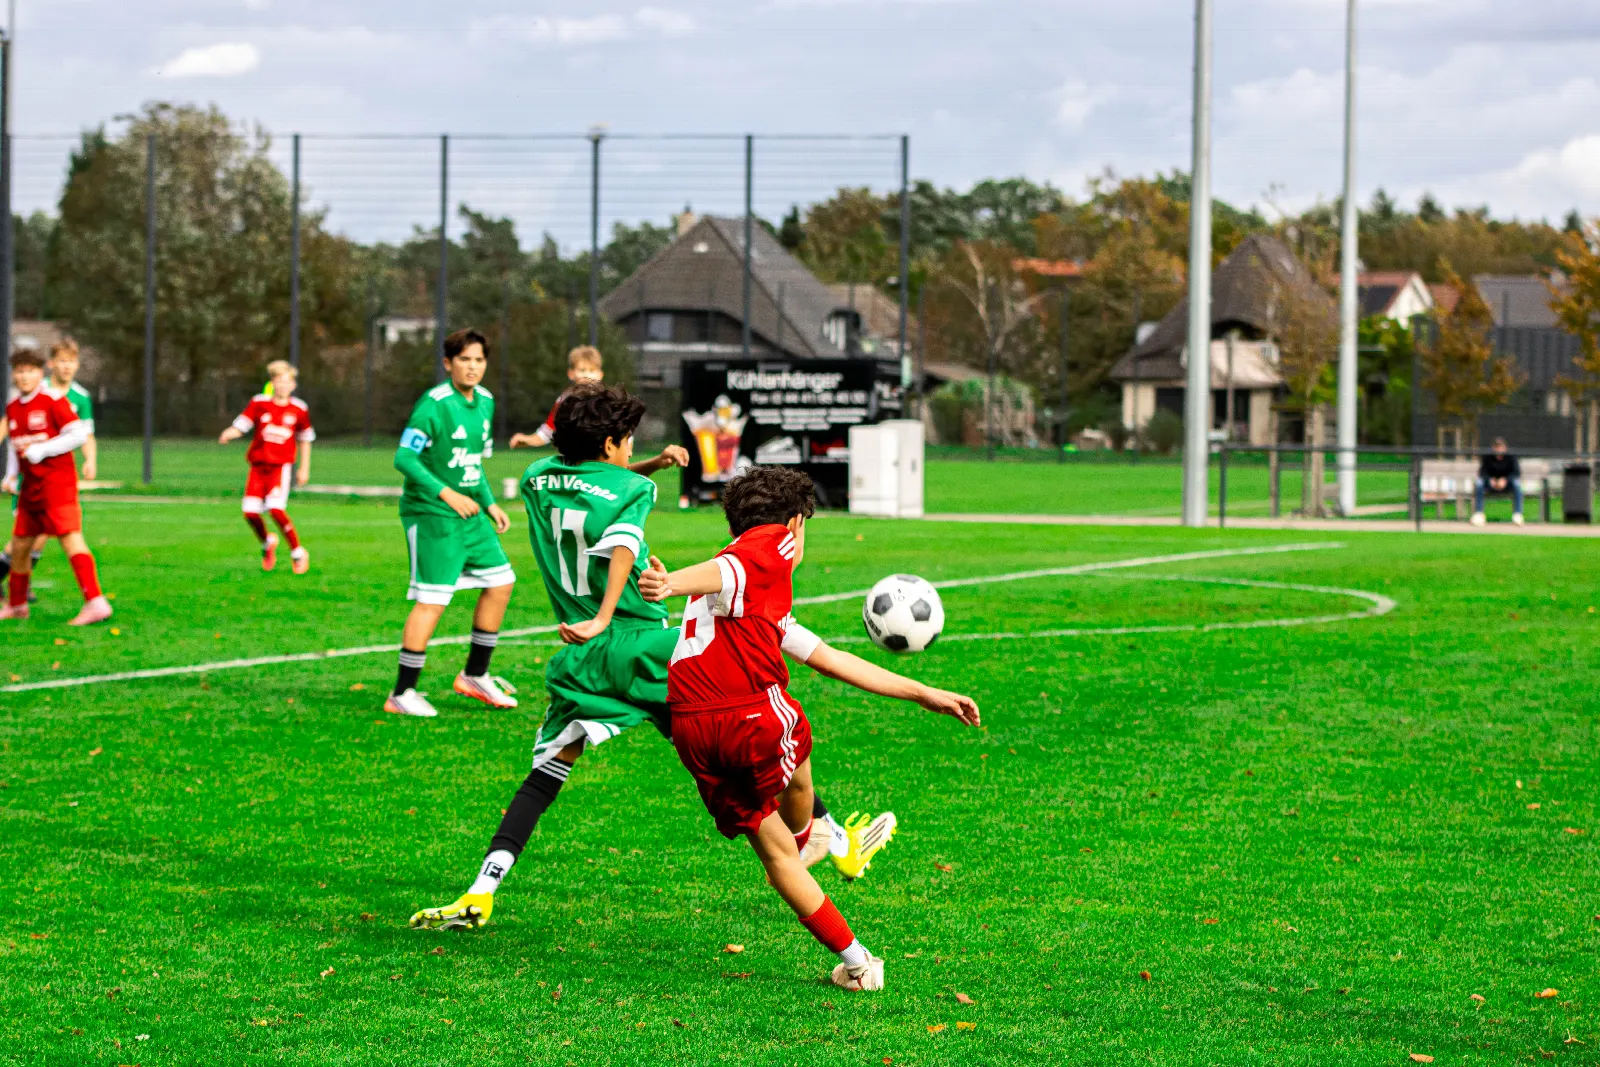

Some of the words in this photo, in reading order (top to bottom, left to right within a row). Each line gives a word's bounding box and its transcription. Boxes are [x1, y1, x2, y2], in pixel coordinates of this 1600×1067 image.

[411, 435, 424, 449] C
[563, 475, 618, 501] Vechta
[551, 508, 592, 597] 17
